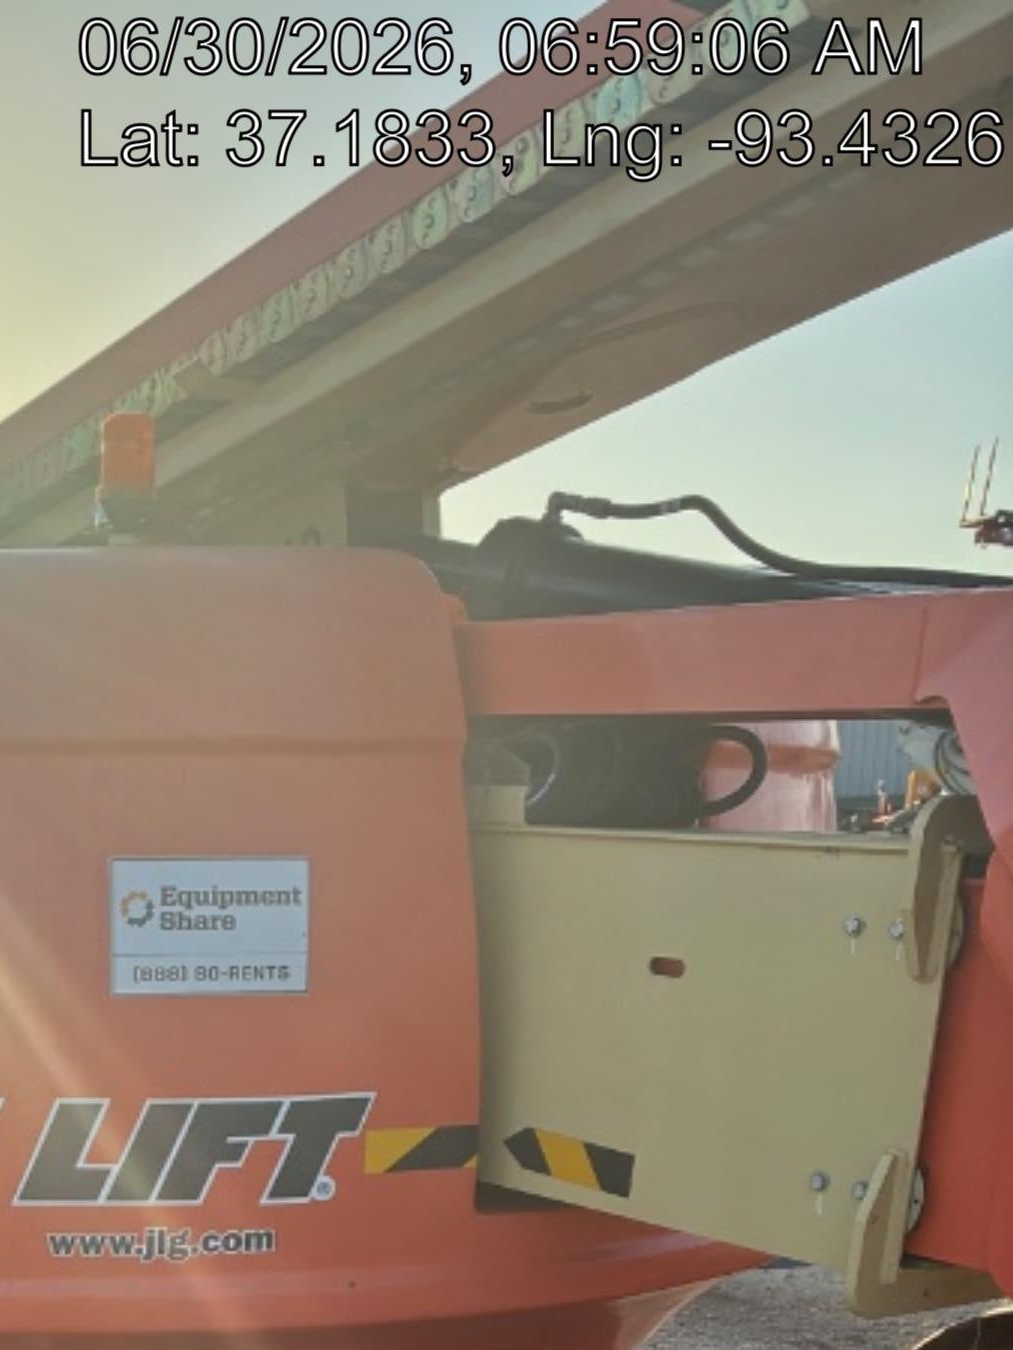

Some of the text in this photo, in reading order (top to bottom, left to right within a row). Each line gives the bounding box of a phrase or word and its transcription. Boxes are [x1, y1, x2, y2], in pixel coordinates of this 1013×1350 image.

[160, 885, 302, 909] Equipment
[160, 911, 236, 931] Share
[48, 1229, 275, 1260] www.jlg.com
